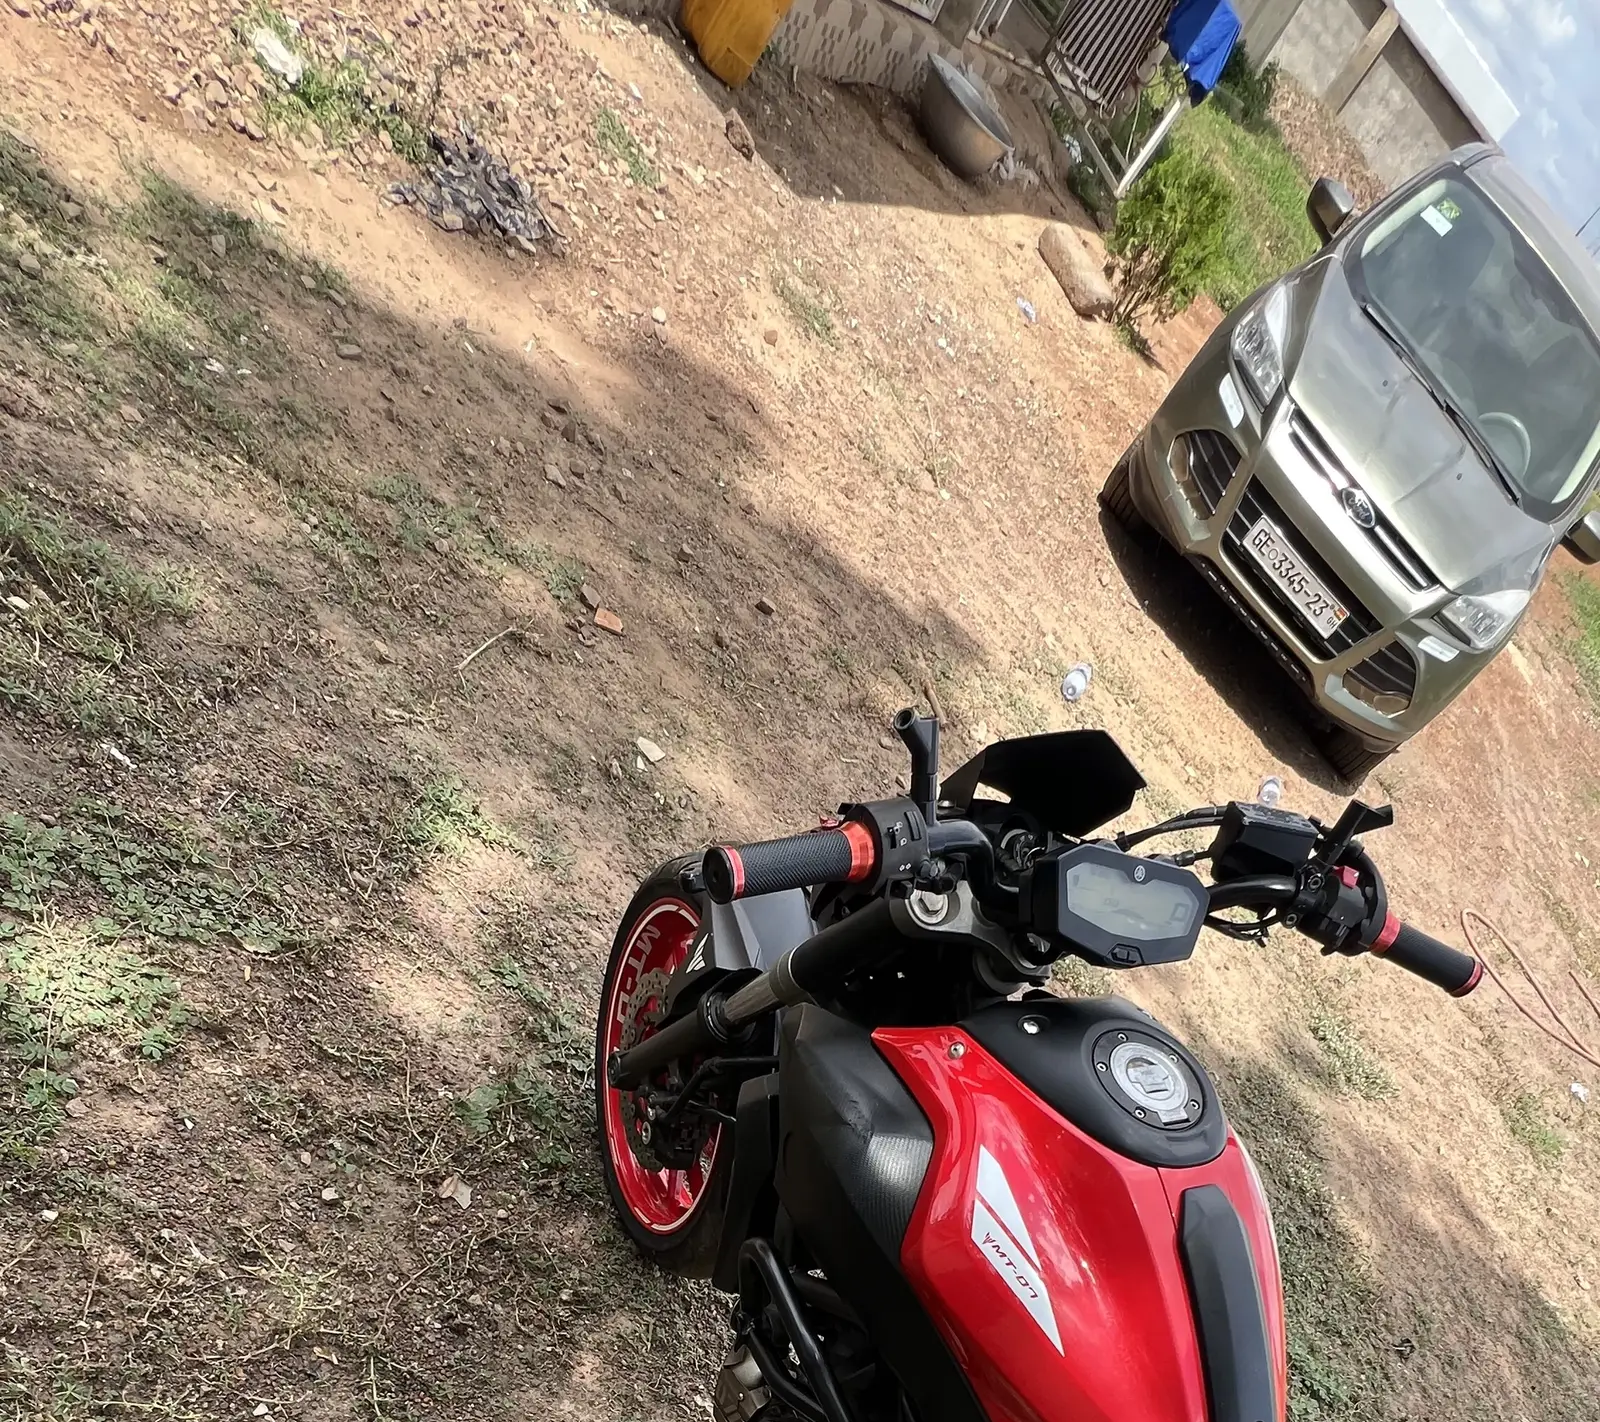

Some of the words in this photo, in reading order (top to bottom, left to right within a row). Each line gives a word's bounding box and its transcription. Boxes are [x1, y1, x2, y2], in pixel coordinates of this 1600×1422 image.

[1252, 528, 1275, 557] GE
[1272, 554, 1329, 617] 3345-23
[991, 1244, 1039, 1299] MT-07
